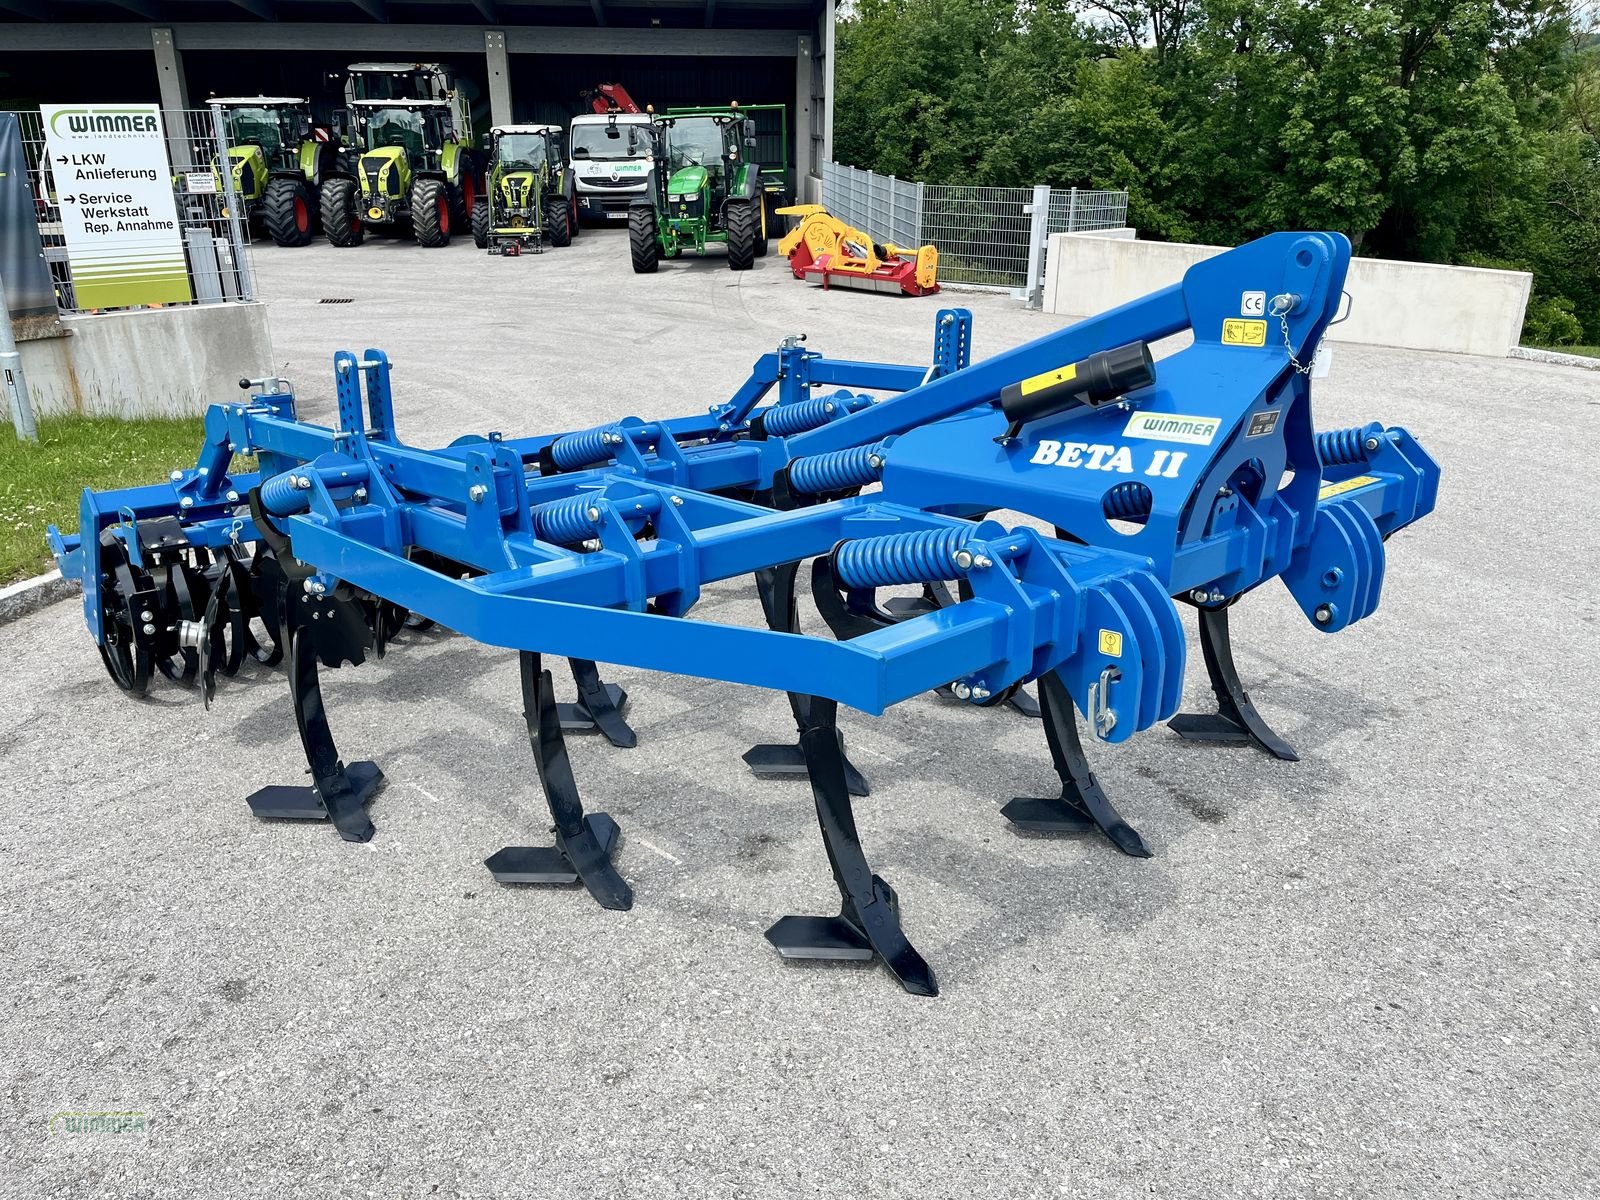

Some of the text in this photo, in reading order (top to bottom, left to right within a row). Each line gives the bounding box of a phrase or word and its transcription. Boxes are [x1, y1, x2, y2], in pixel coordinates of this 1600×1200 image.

[68, 115, 158, 132] WIMMER
[72, 154, 105, 165] LKW
[76, 168, 157, 181] Anlieferung
[79, 192, 132, 205] Service
[81, 206, 149, 219] Werkstatt
[84, 220, 174, 235] Rep. Annahme
[1143, 418, 1215, 437] WIMMER
[1029, 439, 1188, 478] BETA II
